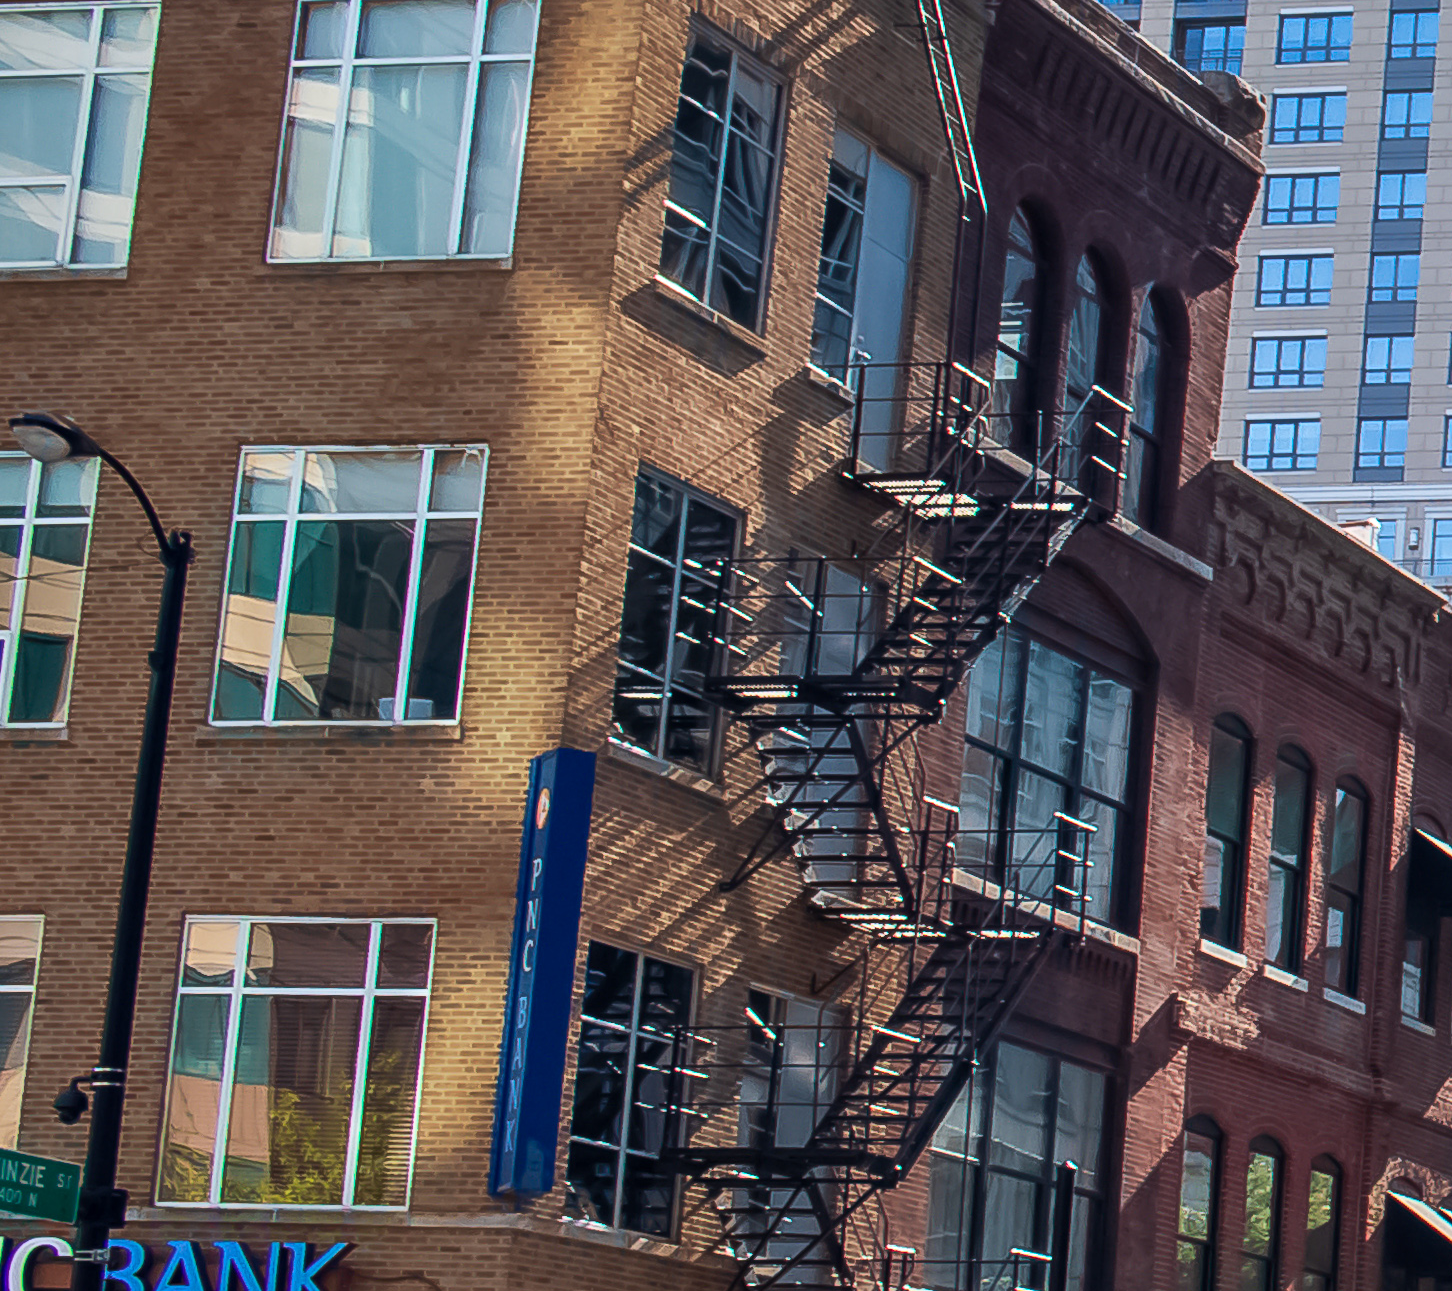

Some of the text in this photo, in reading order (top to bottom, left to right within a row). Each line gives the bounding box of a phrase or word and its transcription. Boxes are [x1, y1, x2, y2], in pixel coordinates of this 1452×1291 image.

[504, 857, 543, 1153] PNC BANK
[0, 1157, 46, 1188] INZIE
[28, 1192, 38, 1208] N
